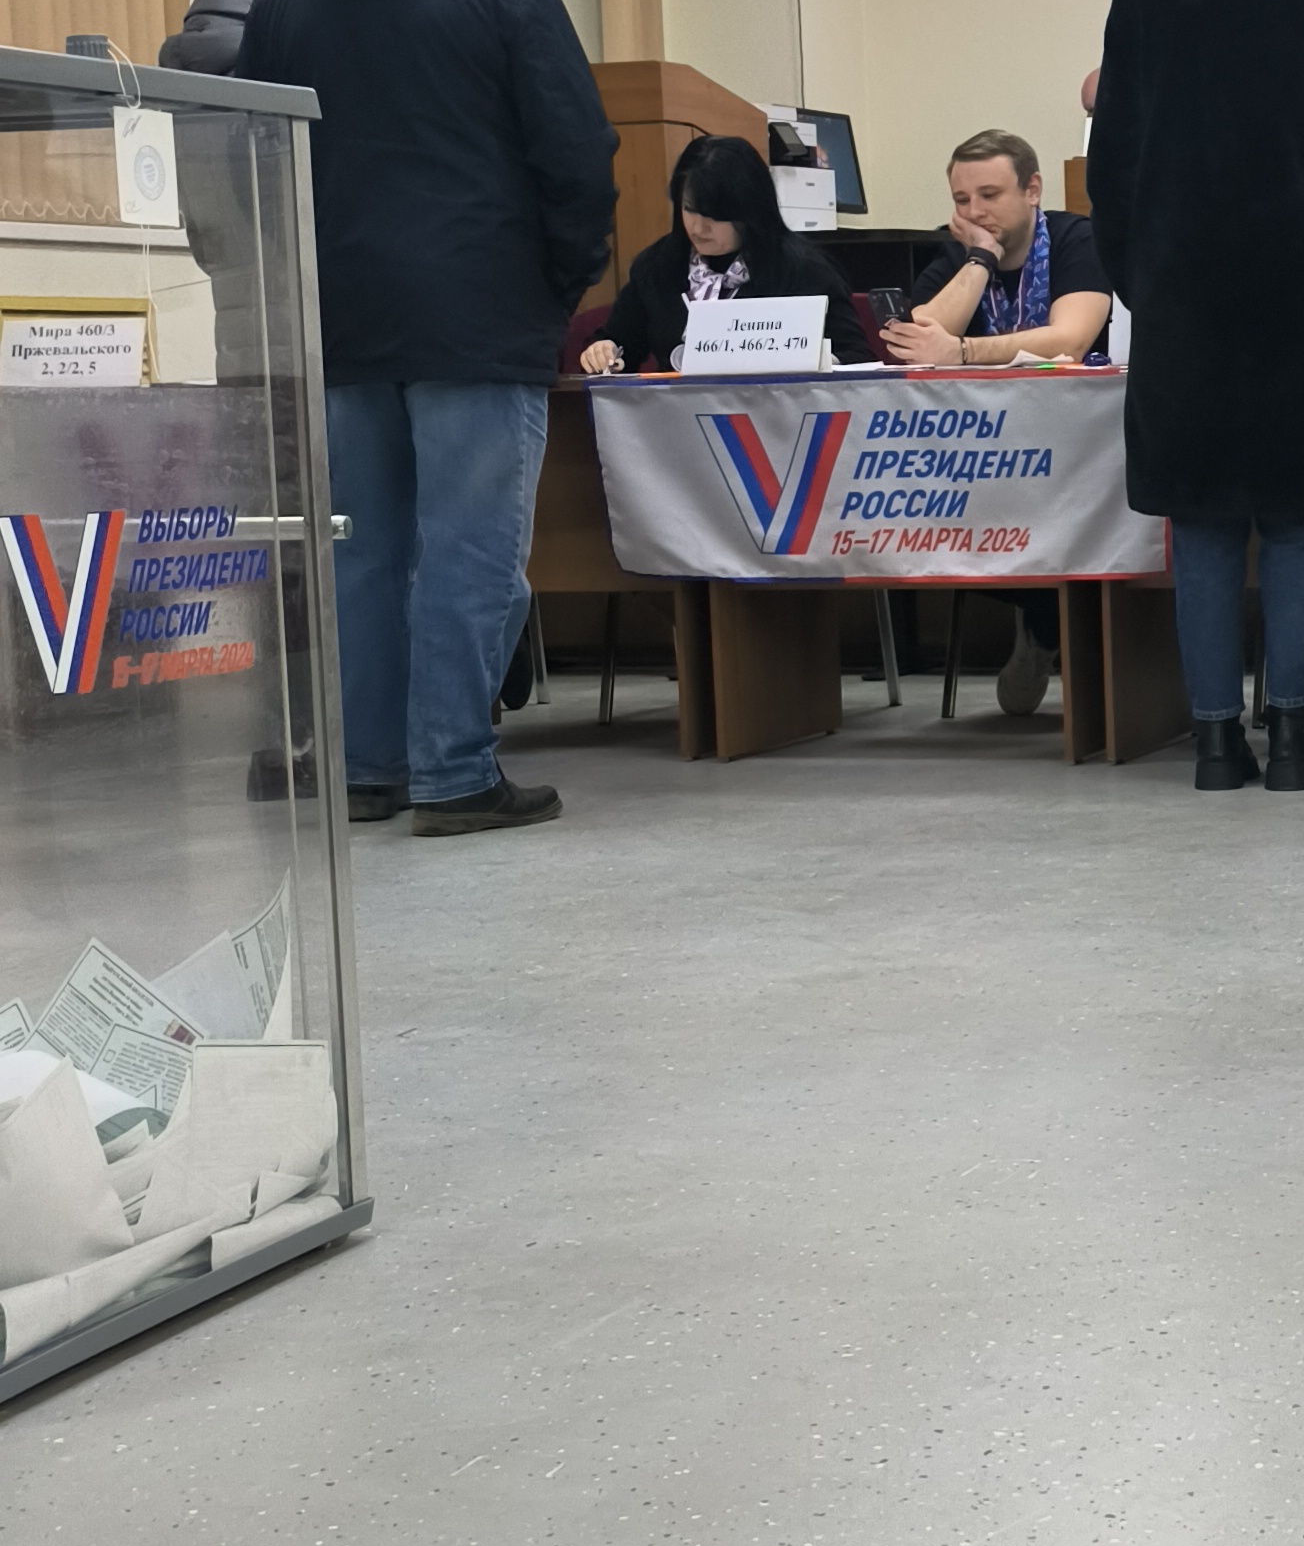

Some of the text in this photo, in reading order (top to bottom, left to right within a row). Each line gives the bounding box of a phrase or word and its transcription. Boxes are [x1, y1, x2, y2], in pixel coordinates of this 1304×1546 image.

[29, 324, 115, 340] Мира 460/3
[727, 318, 782, 332] Ленина
[12, 344, 131, 360] Пржевальского
[694, 336, 808, 353] 466/1, 466/2, 470
[41, 361, 96, 376] 2, 2/2, 5
[866, 409, 1007, 440] ВЫБОРЫ
[852, 448, 1052, 483] ПРЕЗИДЕНТА
[840, 490, 970, 520] РОССИИ
[138, 505, 238, 544] ВЫБОРЫ
[899, 527, 972, 554] МАРТА
[976, 527, 1030, 552] 2024
[128, 549, 268, 593] ПРЕЗИДЕНТА
[119, 601, 212, 642] РОССИИ
